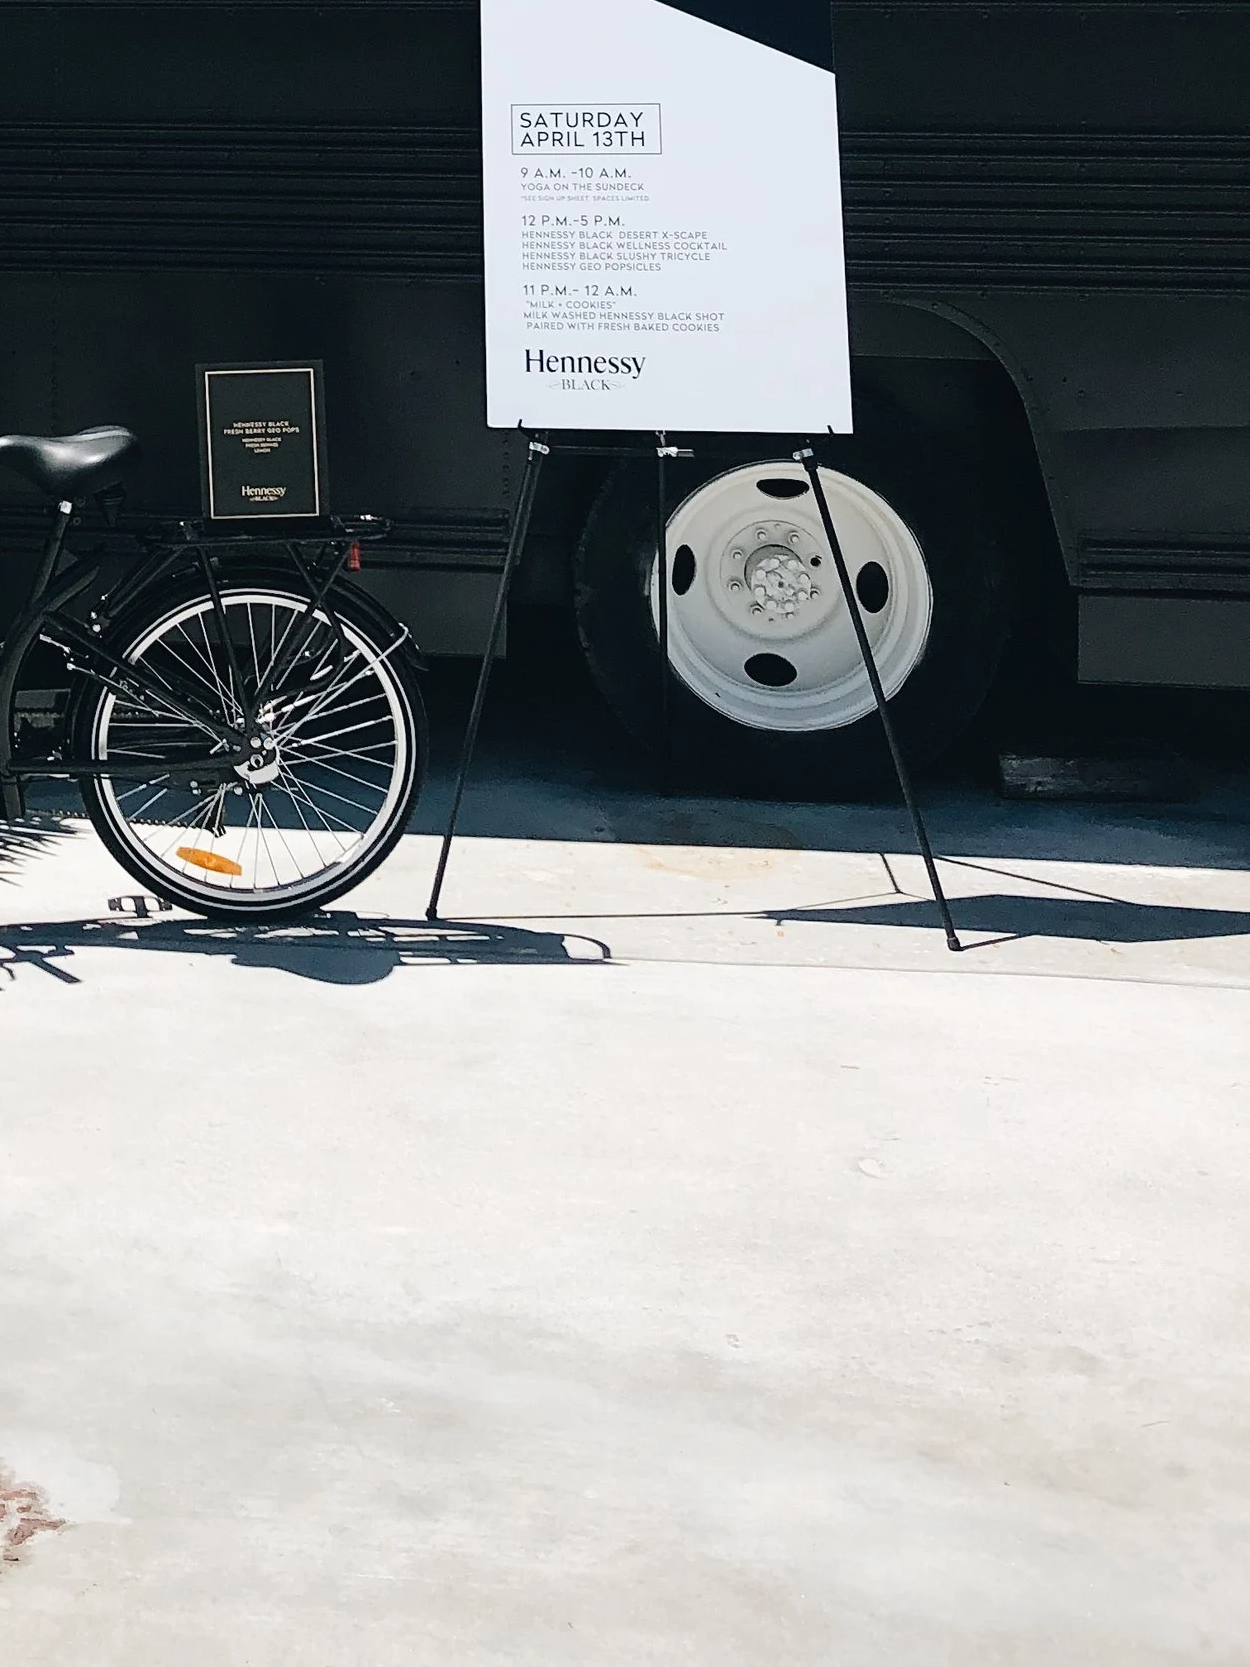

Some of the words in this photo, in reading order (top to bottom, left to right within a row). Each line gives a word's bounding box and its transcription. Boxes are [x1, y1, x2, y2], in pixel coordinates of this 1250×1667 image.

[520, 112, 643, 128] SATURDAY
[521, 131, 585, 147] APRIL
[592, 131, 645, 147] 13TH
[520, 167, 528, 178] 9
[534, 167, 566, 178] A.M.
[599, 167, 632, 178] A.M.
[521, 183, 551, 191] YOGA
[553, 183, 569, 191] ON
[573, 183, 592, 191] THE
[595, 183, 644, 191] SUNDECK
[522, 215, 536, 227] 12
[594, 215, 625, 227] P.M.
[522, 231, 575, 239] HENNESSY
[579, 231, 613, 239] BLACK
[619, 231, 657, 239] DESERT
[662, 231, 708, 240] X-SCAPE
[617, 242, 670, 250] WELLNESS
[673, 242, 728, 250] COCKTAIL
[522, 252, 575, 260] HENNESSY
[579, 252, 613, 260] BLACK
[660, 253, 710, 261] TRICYCLE
[605, 263, 661, 271] POPSICLES
[524, 285, 535, 296] 11
[584, 285, 599, 296] 12
[604, 285, 637, 297] A.M.
[523, 311, 548, 319] MILK
[551, 312, 596, 320] WASHED
[599, 312, 654, 320] HENNESSY
[657, 312, 691, 320] BLACK
[695, 312, 725, 321] SHOT
[526, 322, 564, 330] PAIRED
[567, 322, 594, 331] WITH
[598, 322, 630, 331] FRESH
[634, 323, 669, 331] BAKED
[672, 323, 720, 332] COOKIES
[525, 349, 646, 379] Hennessy
[561, 379, 611, 390] BLACK
[242, 486, 286, 497] Hennessy
